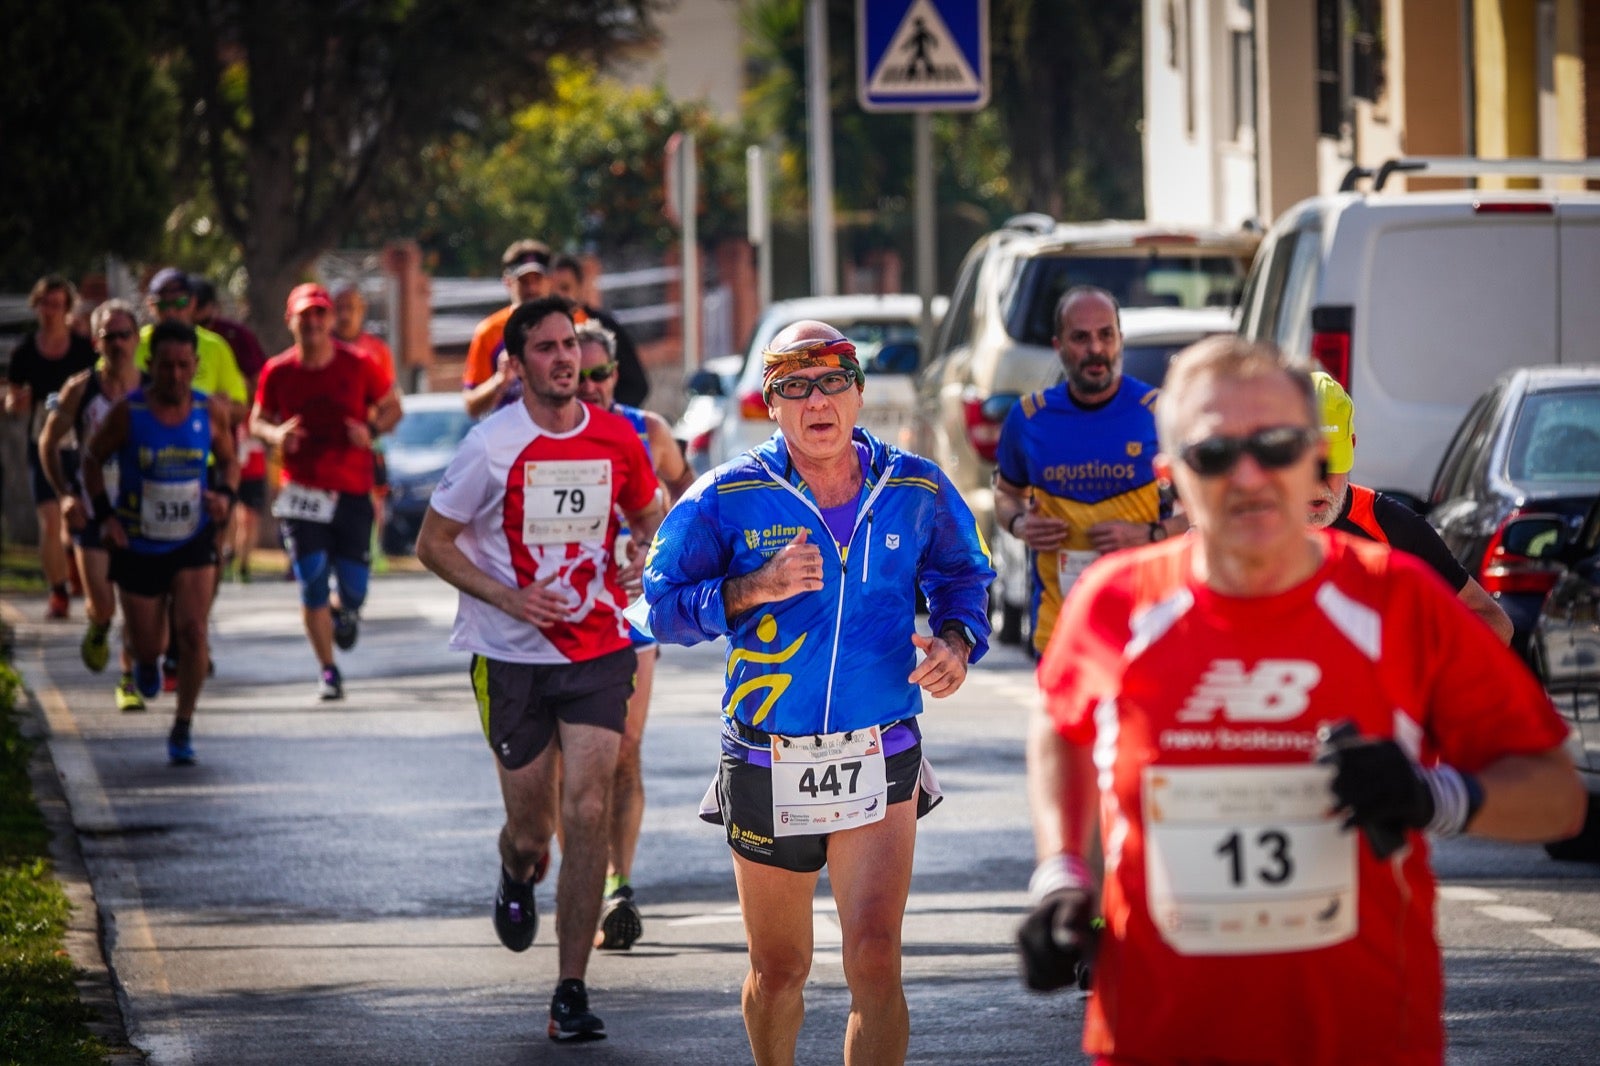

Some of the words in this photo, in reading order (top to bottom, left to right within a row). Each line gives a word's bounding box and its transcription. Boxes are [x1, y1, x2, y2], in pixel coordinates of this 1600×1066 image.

[1043, 460, 1135, 485] agustinos
[553, 489, 585, 514] 79
[1176, 658, 1321, 722] NB
[1160, 730, 1213, 749] new
[1215, 727, 1317, 750] balanc
[799, 761, 862, 798] 447
[741, 830, 774, 845] olimpo
[1216, 830, 1294, 887] 13
